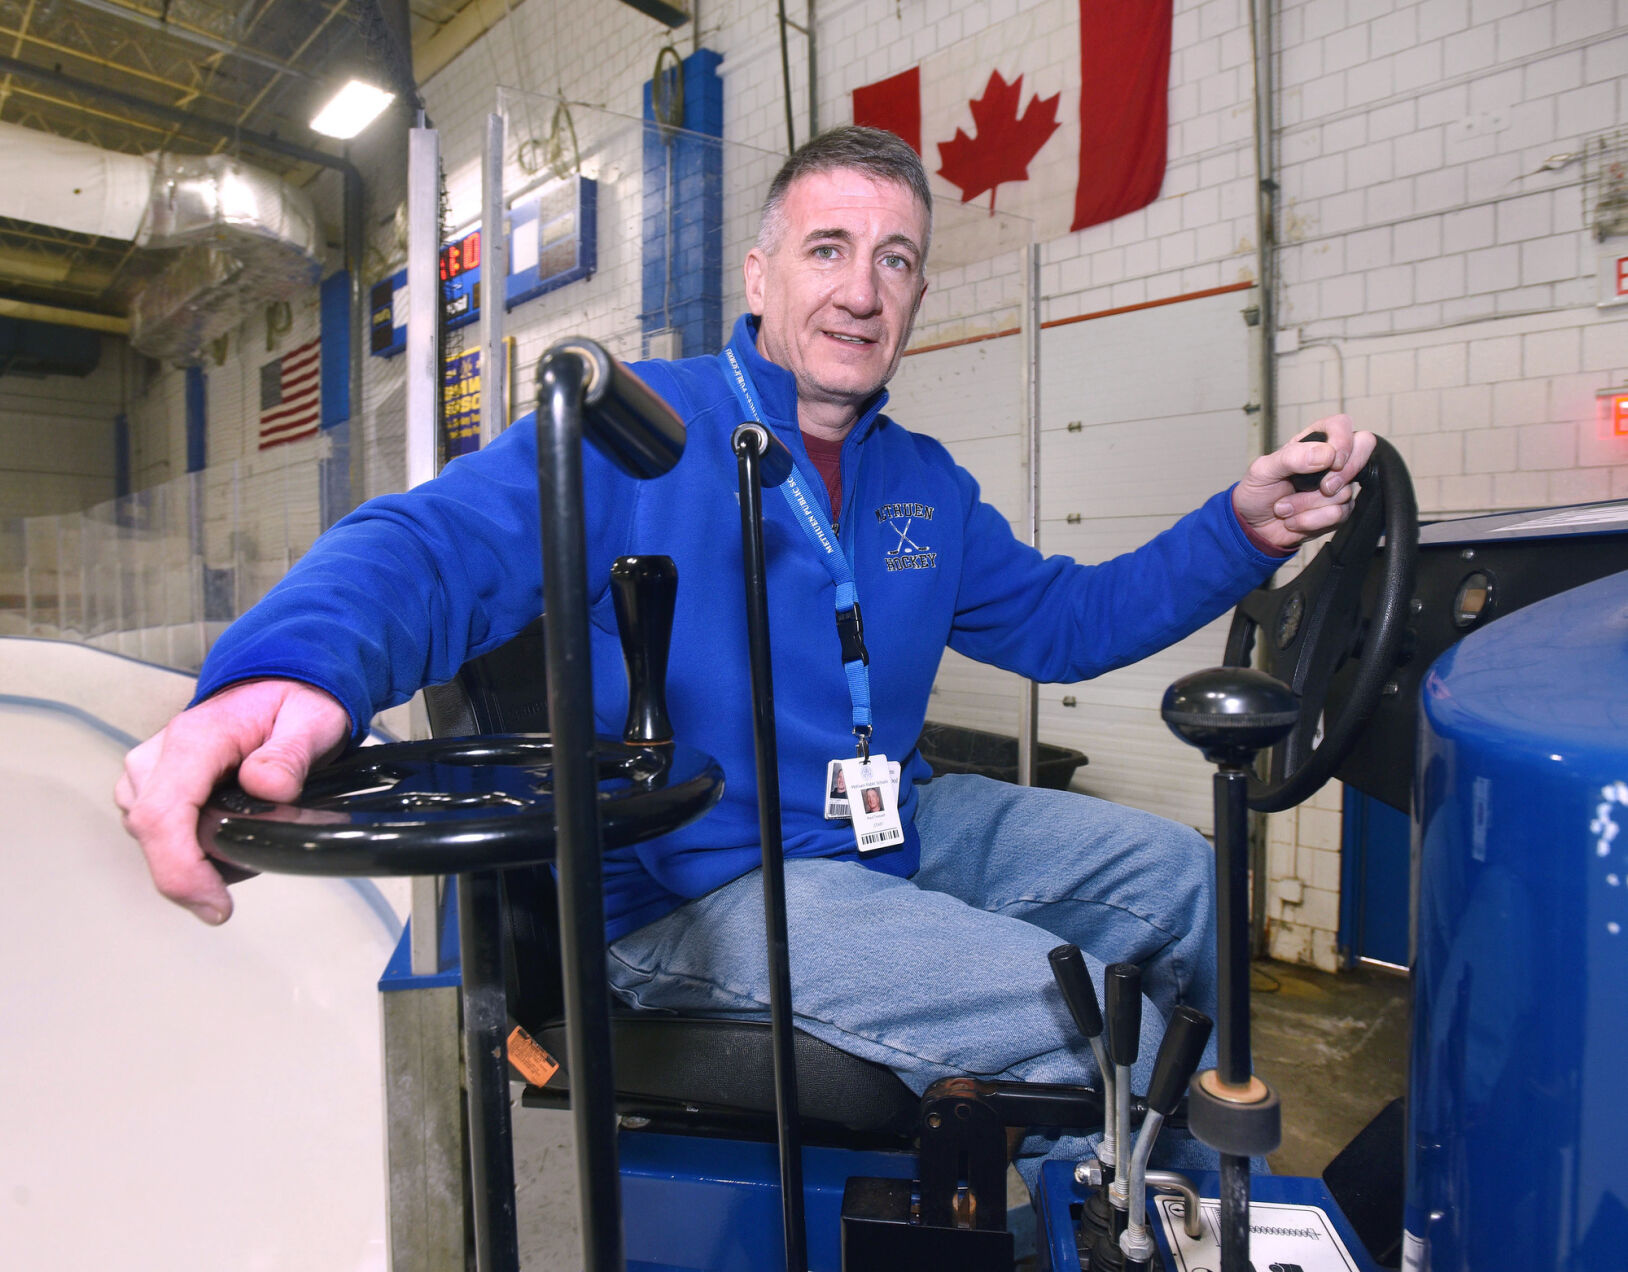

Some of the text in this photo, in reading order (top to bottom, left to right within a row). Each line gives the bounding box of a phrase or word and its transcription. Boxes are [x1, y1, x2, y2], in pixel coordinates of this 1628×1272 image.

[792, 486, 812, 516] PUBLIC
[807, 515, 835, 555] METHUEN
[884, 552, 937, 572] HOCKEY
